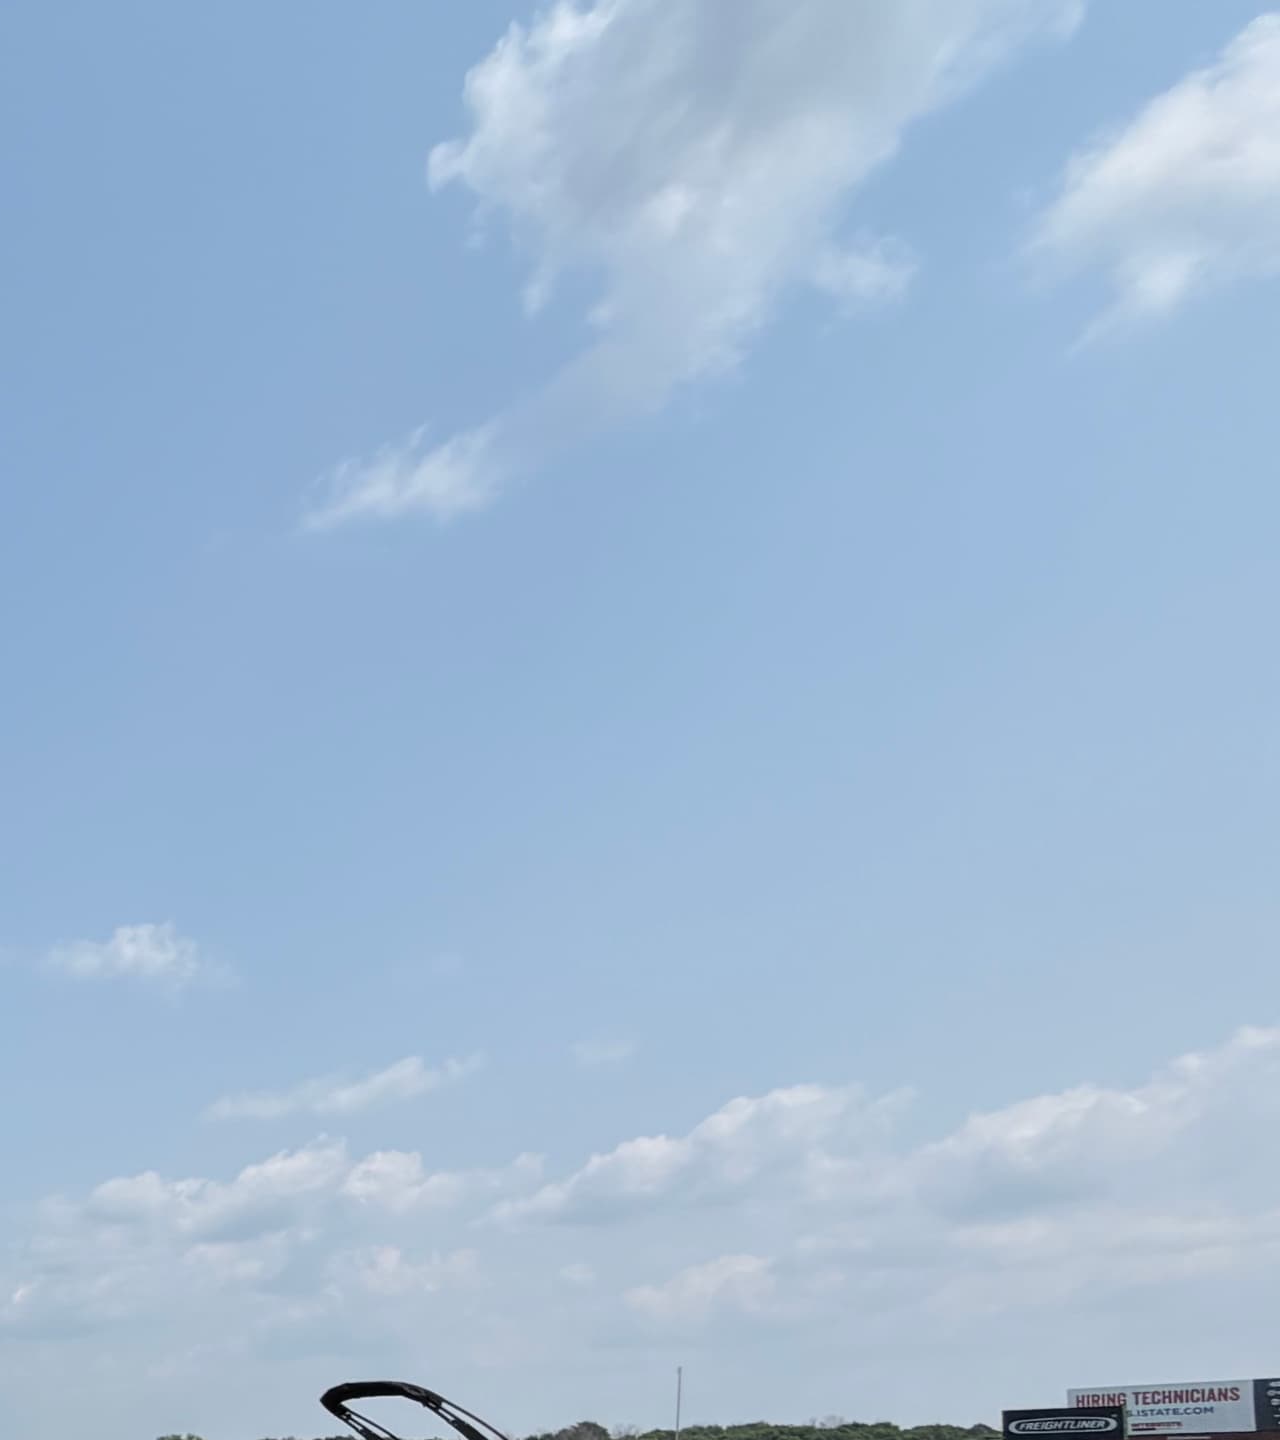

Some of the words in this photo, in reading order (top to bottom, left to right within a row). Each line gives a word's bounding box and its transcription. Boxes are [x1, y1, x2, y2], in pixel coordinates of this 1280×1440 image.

[1076, 1392, 1127, 1408] HIRING
[1132, 1387, 1240, 1406] TECHNICIANS
[1018, 1420, 1106, 1431] FREIGHTLINER
